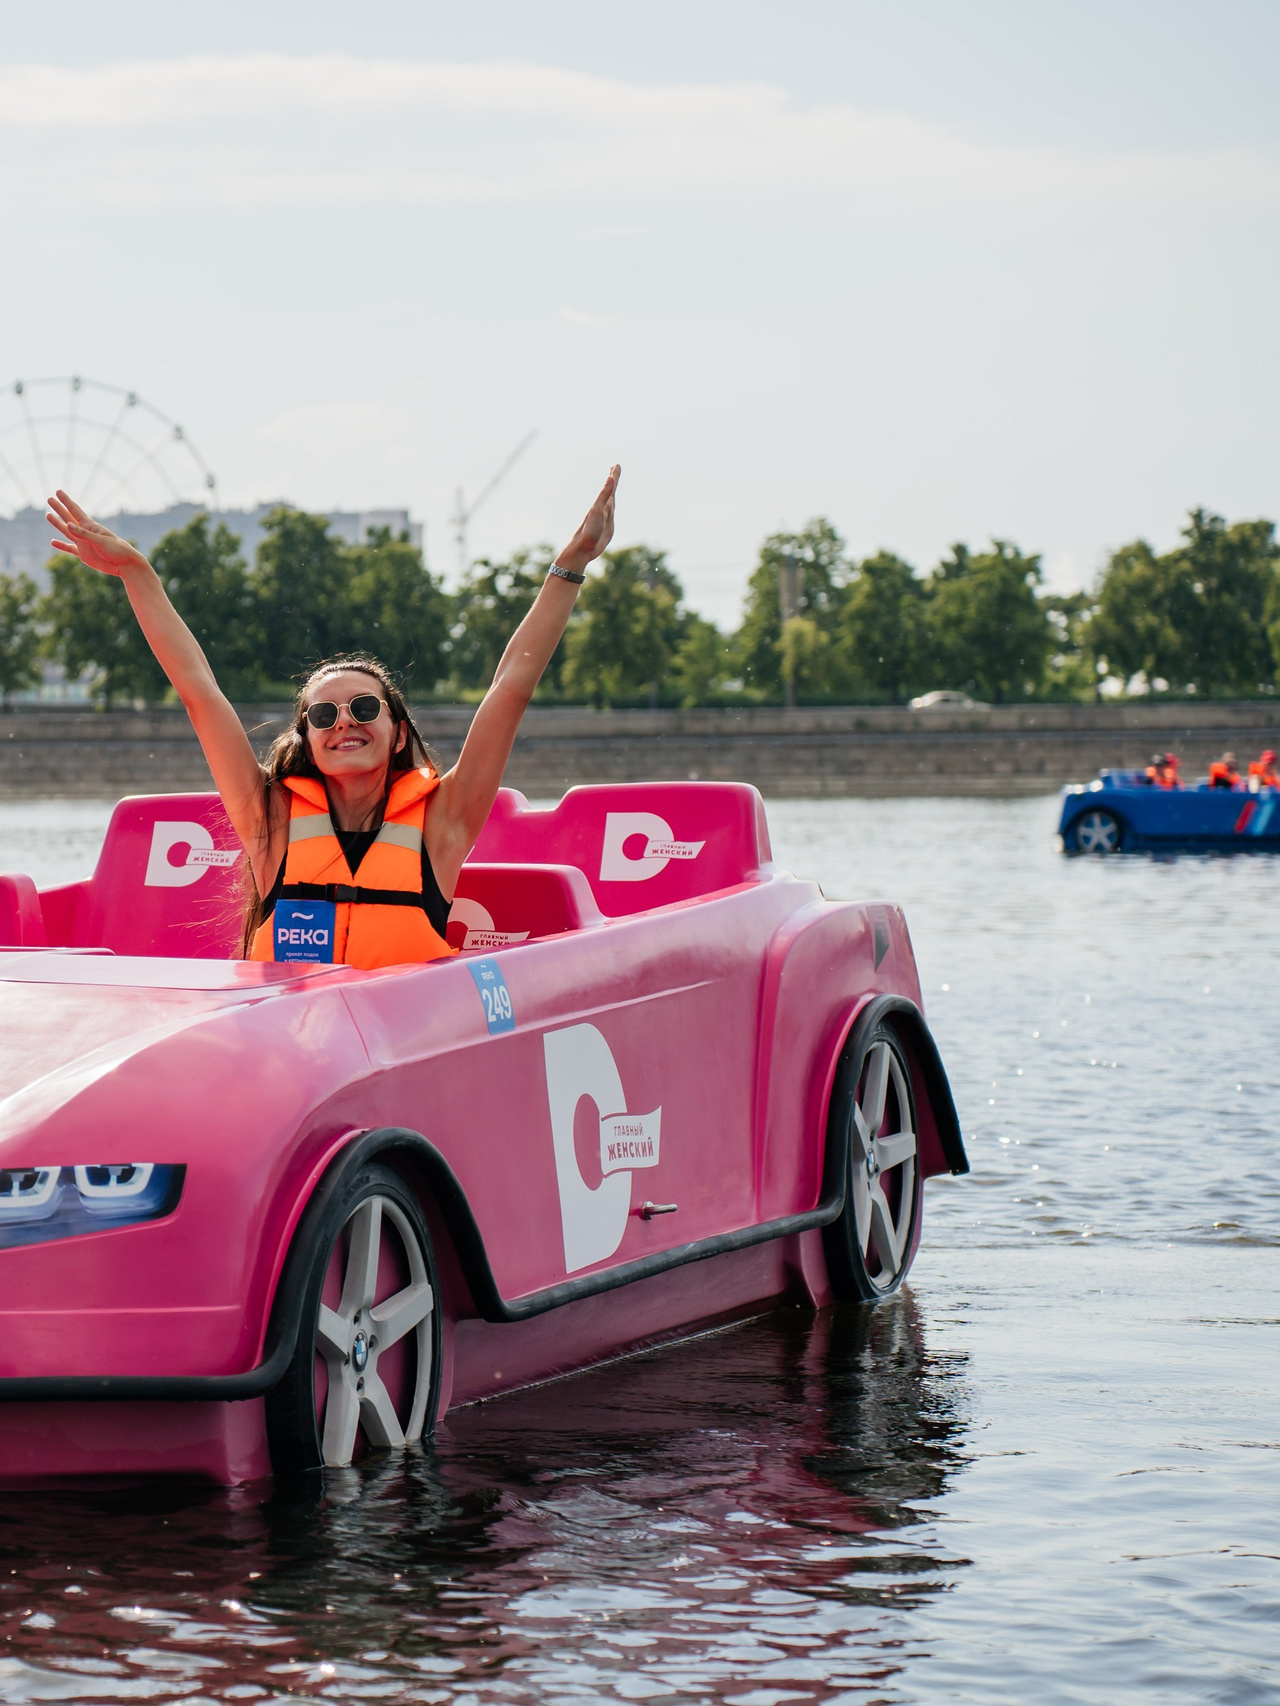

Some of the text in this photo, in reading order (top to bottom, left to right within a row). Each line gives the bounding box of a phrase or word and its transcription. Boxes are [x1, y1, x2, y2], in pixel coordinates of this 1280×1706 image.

[192, 855, 230, 863] ЖЕНСКИЙ
[651, 848, 693, 856] ЖЕНСКИЙ
[482, 985, 512, 1023] 249
[613, 1122, 643, 1136] ГЛАВНЫЙ
[607, 1136, 654, 1161] ЖЕНСКИЙ
